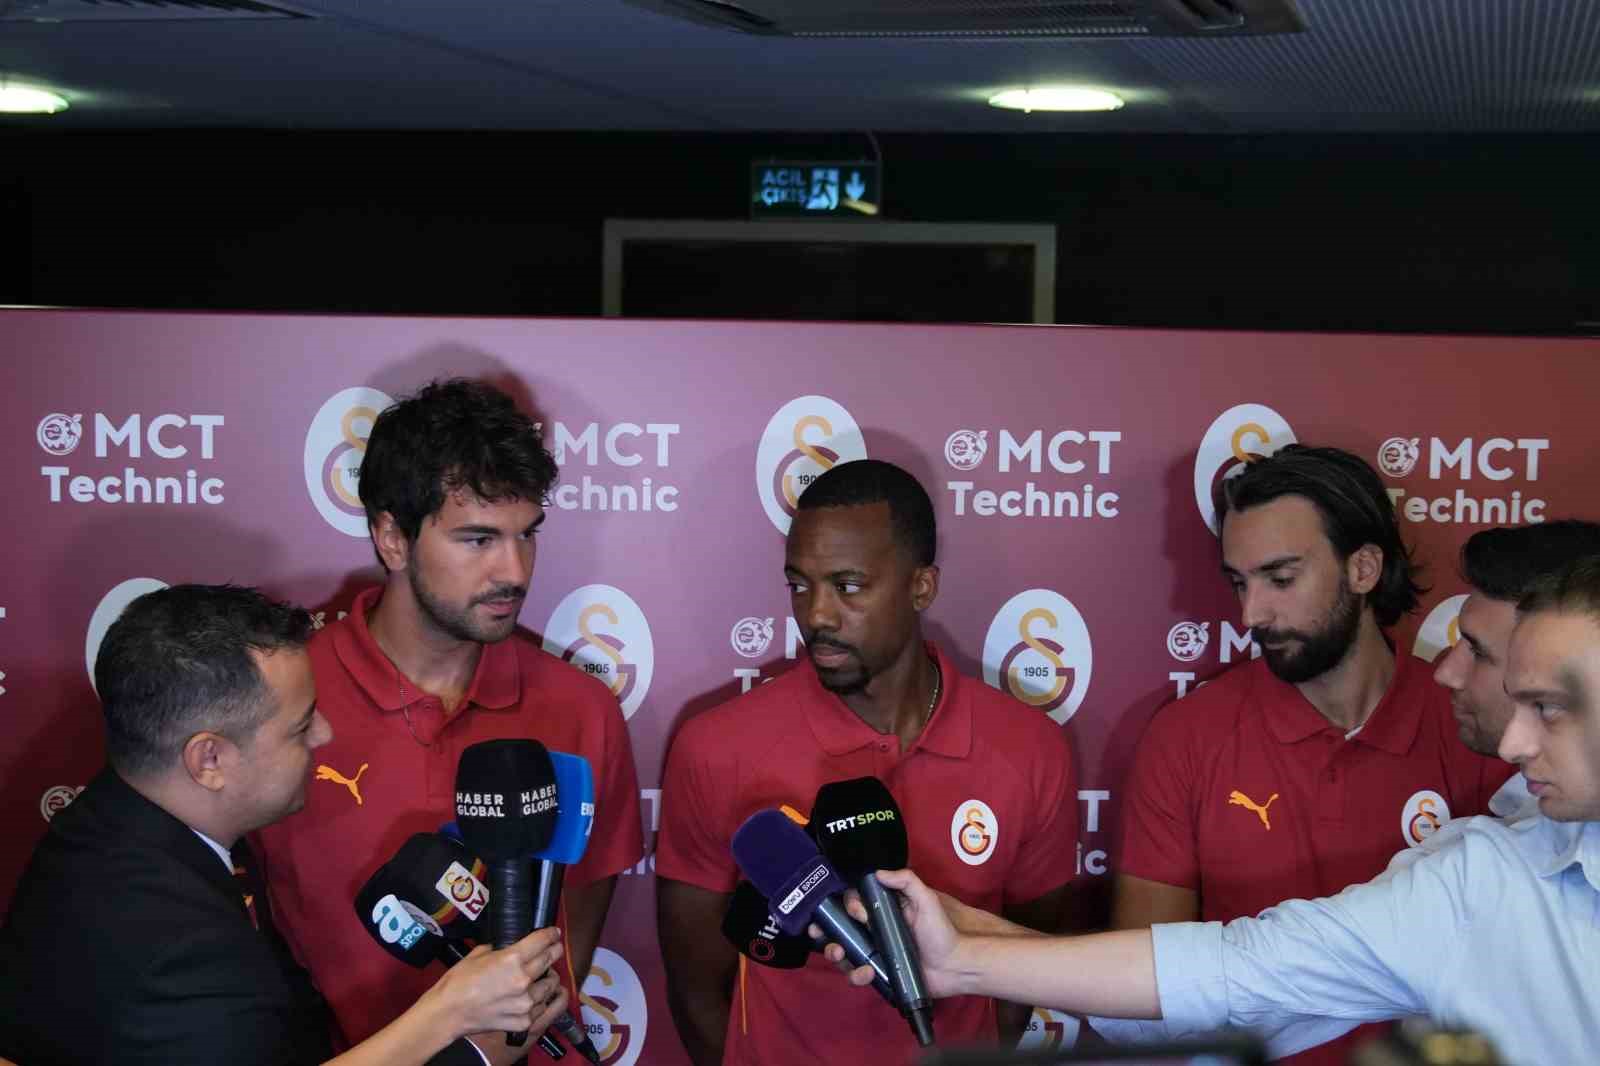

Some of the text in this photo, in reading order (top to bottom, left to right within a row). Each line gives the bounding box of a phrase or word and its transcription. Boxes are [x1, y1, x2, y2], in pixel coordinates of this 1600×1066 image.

[94, 412, 225, 459] MCT
[554, 421, 681, 467] MCT
[998, 429, 1122, 474] MCT
[1429, 437, 1550, 481] MCT
[40, 465, 225, 505] Technic
[542, 475, 681, 512] chnic
[946, 481, 1120, 519] Technic
[584, 663, 610, 674] 1905
[1023, 666, 1049, 677] 1905
[456, 792, 504, 805] HABER
[457, 804, 505, 817] GLOBAL
[521, 784, 557, 803] HABER
[801, 867, 827, 892] SPORTS
